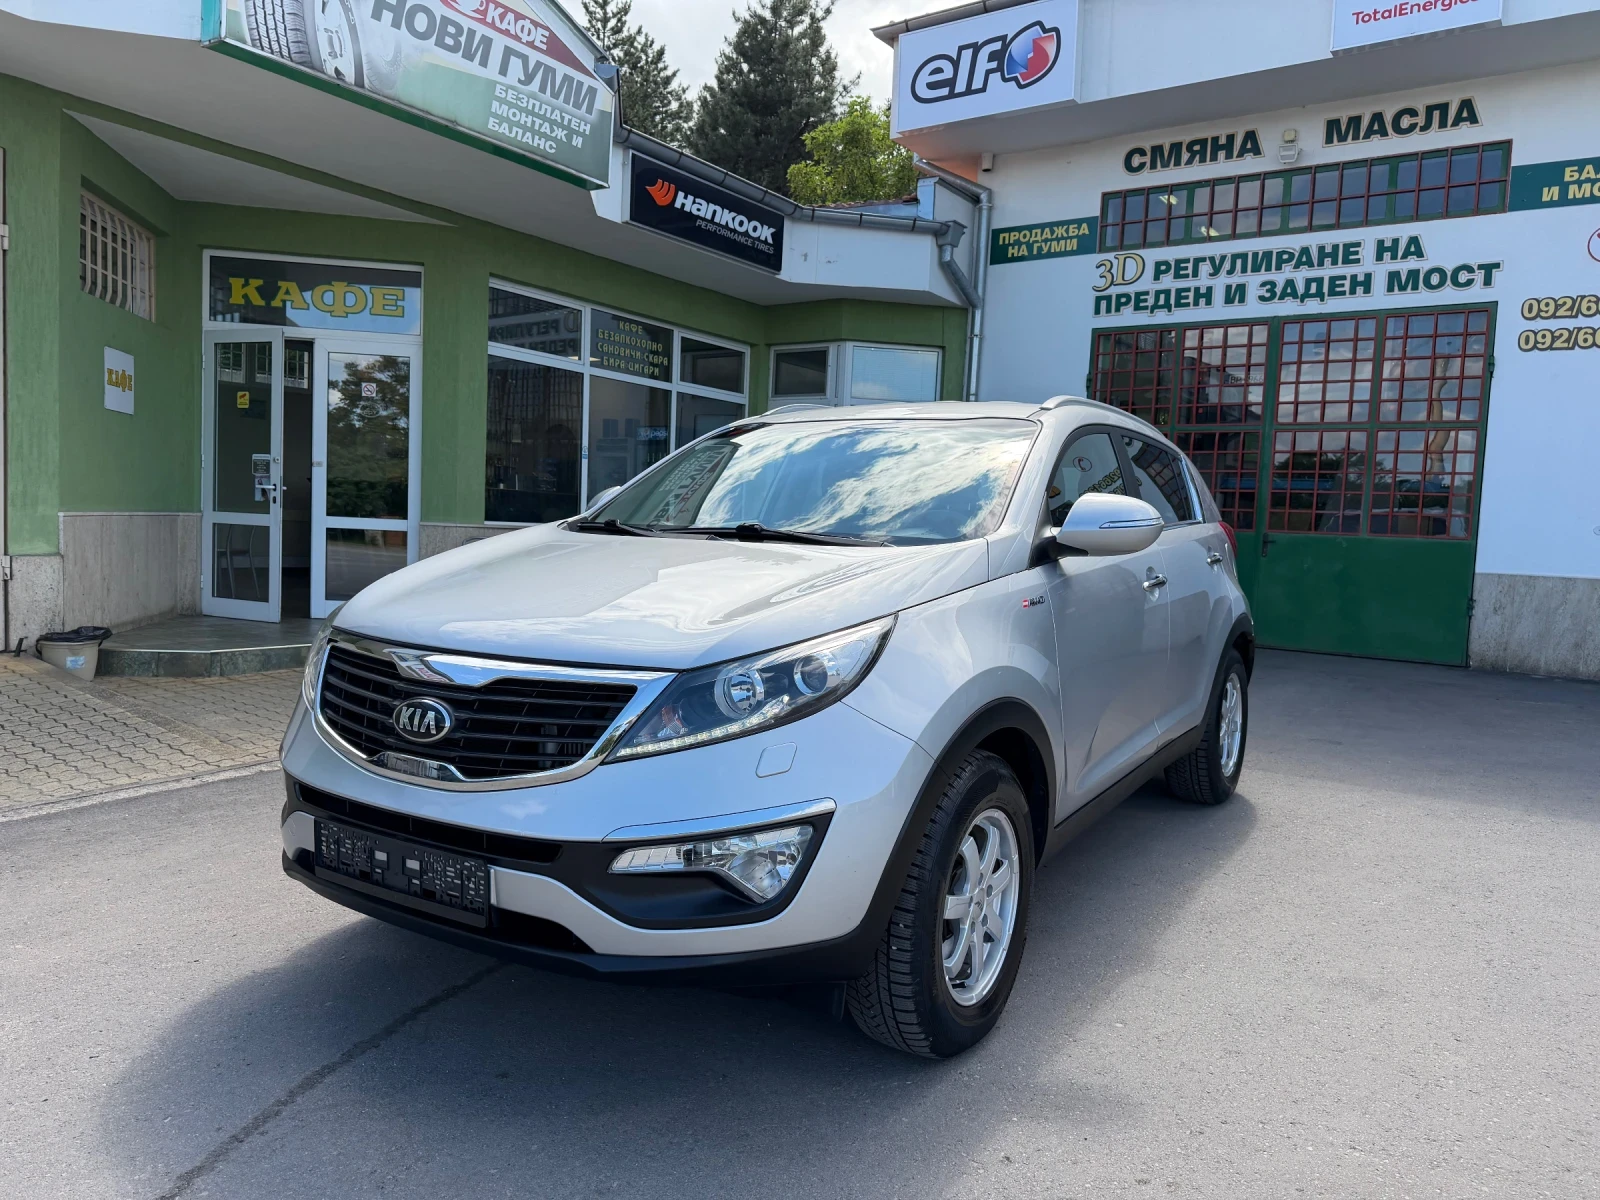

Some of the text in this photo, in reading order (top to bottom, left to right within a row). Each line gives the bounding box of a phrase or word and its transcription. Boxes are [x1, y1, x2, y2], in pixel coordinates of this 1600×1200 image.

[486, 3, 550, 50] КАФЕ
[1352, 0, 1478, 25] TotalEnerg
[370, 0, 598, 116] НОВИ ГУМИ
[911, 34, 1008, 104] elf
[491, 100, 583, 148] МОНТАЖ И
[495, 84, 591, 135] БЕЗПЛАТЕН
[488, 117, 556, 154] БАЛАНС
[1123, 97, 1481, 174] СМЯНА МАСЛА
[1564, 164, 1600, 181] БА
[1542, 186, 1559, 202] И
[696, 219, 774, 254] PERFORMANCE TIRES
[999, 223, 1089, 245] ПРОДАЖБА
[1008, 238, 1078, 258] НА ГУМИ
[1092, 235, 1426, 292] 3D РЕГУЛИРАНЕ НА
[229, 277, 405, 318] КАФЕ
[1093, 262, 1502, 316] ПРЕДЕН И ЗАДЕН МОСТ
[1521, 295, 1600, 320] 092/6
[619, 320, 643, 335] КАФЕ
[107, 368, 133, 392] КАФЕ
[399, 706, 438, 735] KIA
